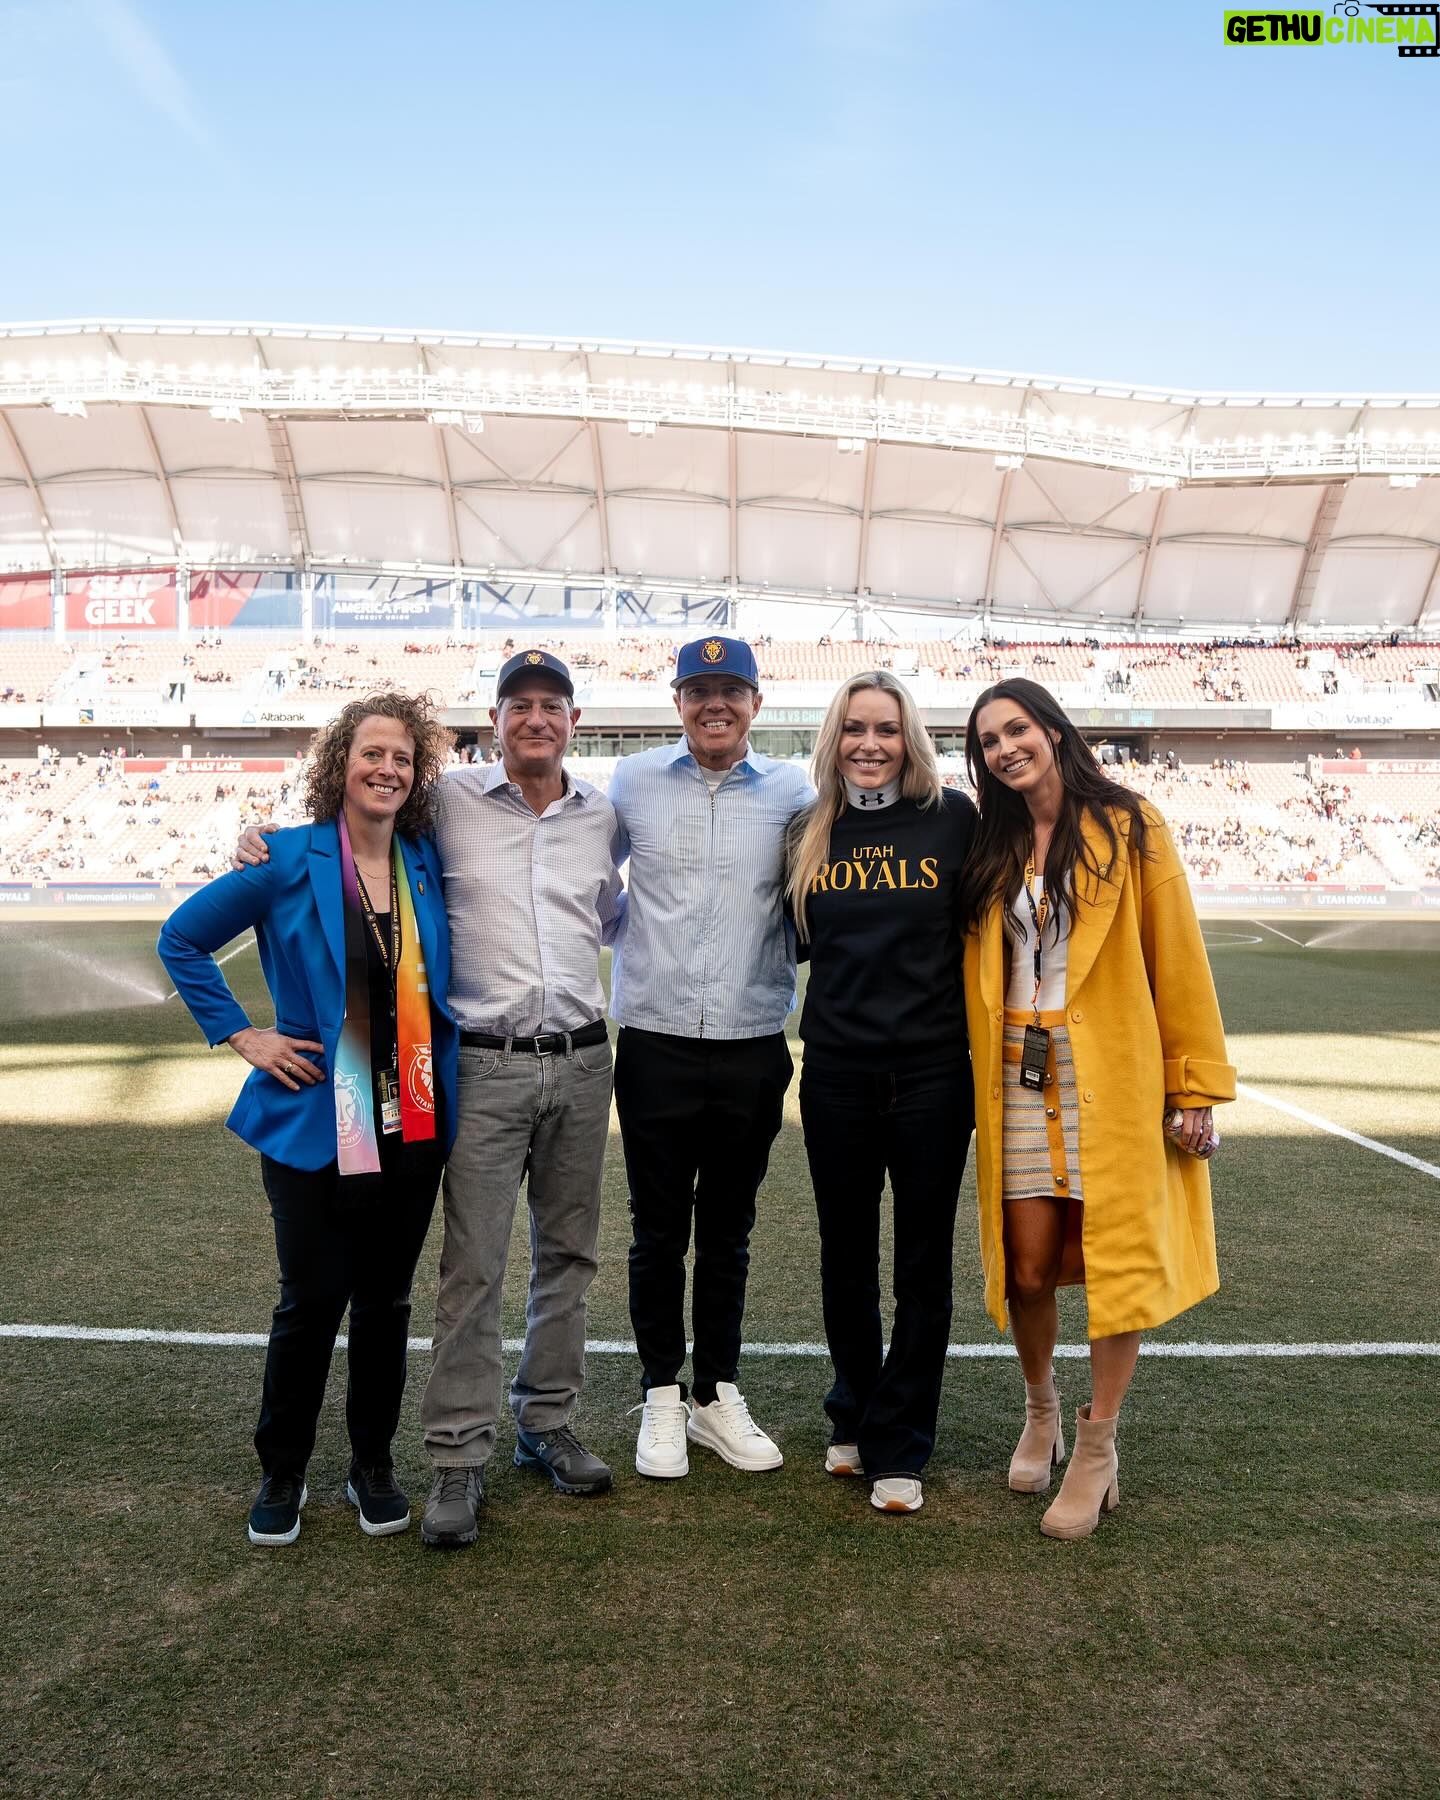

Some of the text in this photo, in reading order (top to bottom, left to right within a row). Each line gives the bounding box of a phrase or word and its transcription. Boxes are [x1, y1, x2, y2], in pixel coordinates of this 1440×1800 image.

[84, 599, 157, 625] GEEK
[332, 602, 432, 614] AMERICA FIRST
[260, 712, 306, 722] Altabank
[853, 845, 894, 859] UTAH
[812, 858, 939, 893] ROYALS
[416, 1095, 431, 1108] UTAH
